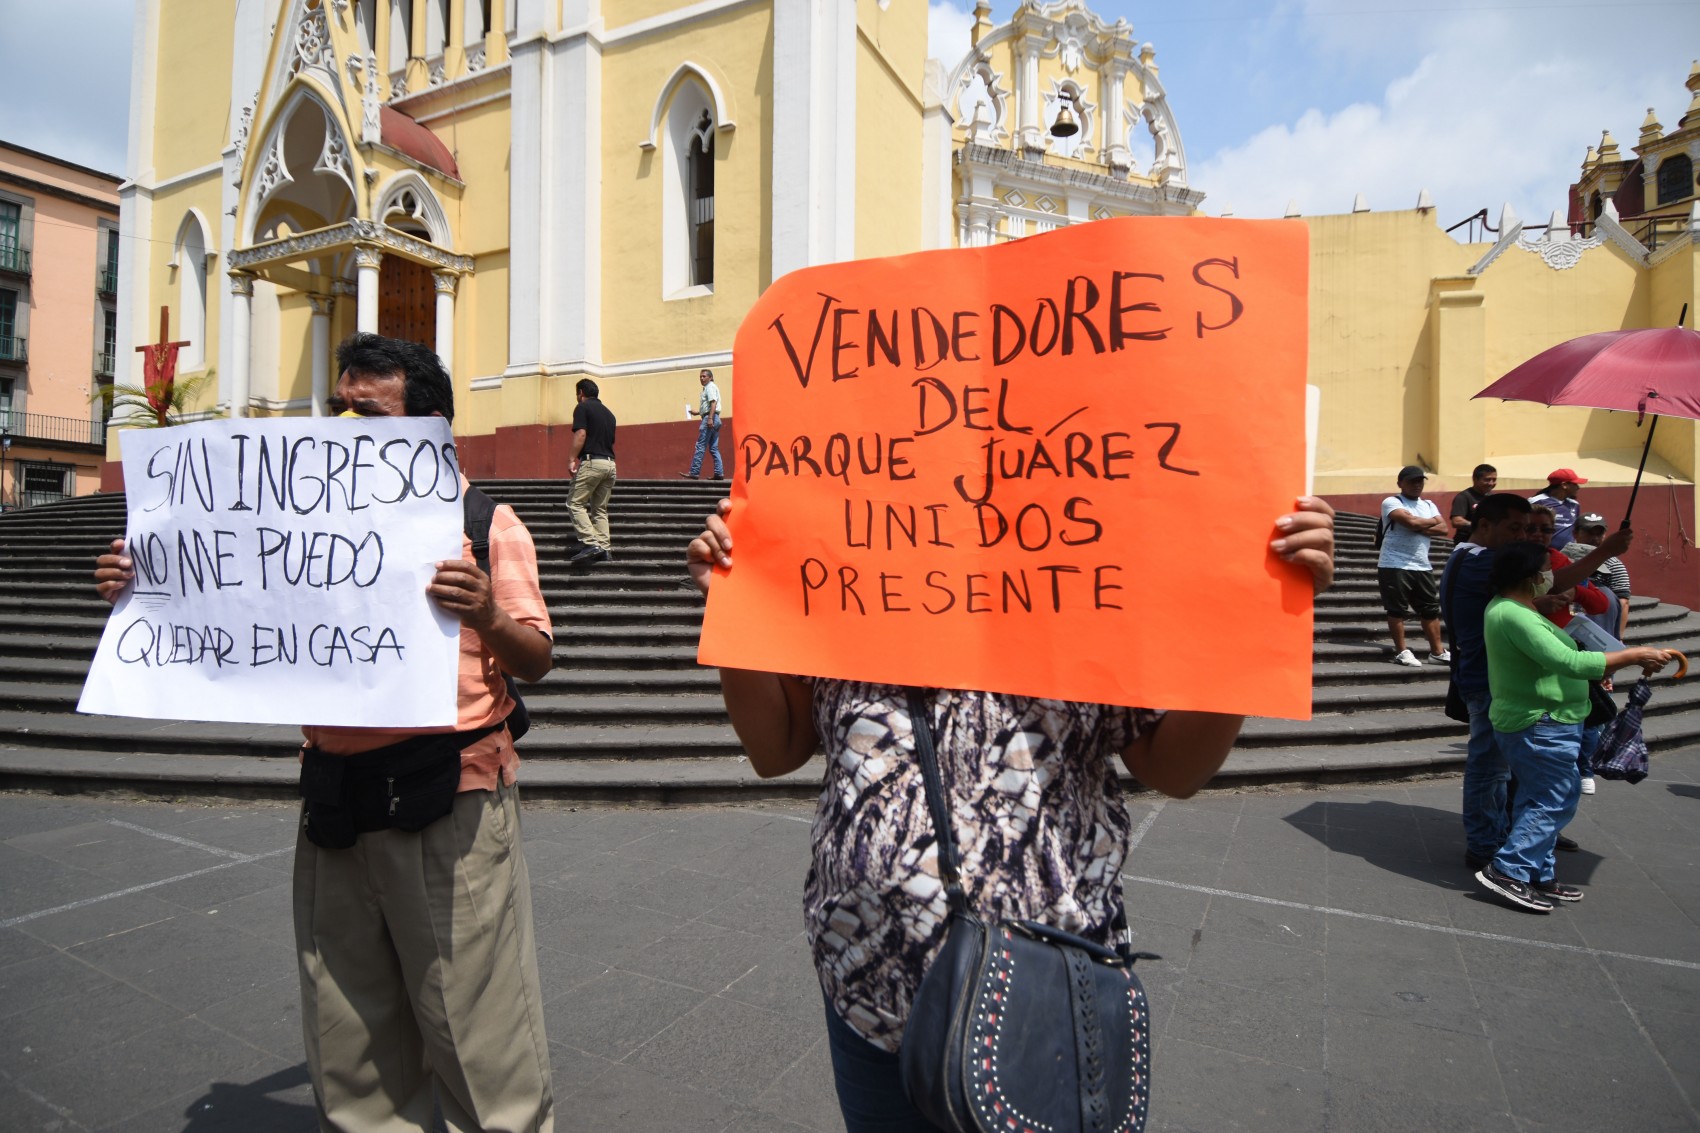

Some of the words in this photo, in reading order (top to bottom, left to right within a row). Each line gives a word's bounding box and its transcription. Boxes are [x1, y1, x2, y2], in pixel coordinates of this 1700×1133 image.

[768, 256, 1244, 389] VENDEDORES
[912, 377, 1033, 436] DEL
[144, 438, 213, 513] SIN
[228, 434, 459, 515] INGRESOS
[740, 432, 917, 485] PARQUE
[953, 405, 1200, 501] JUÁREZ
[845, 498, 1104, 551] UNIDOS
[129, 531, 168, 587] NO
[178, 528, 243, 597] ME
[256, 527, 384, 590] PUEDO
[800, 558, 1124, 616] PRESENTE
[116, 617, 240, 668] QUEDAR
[250, 623, 298, 667] EN
[308, 623, 405, 667] CASA
